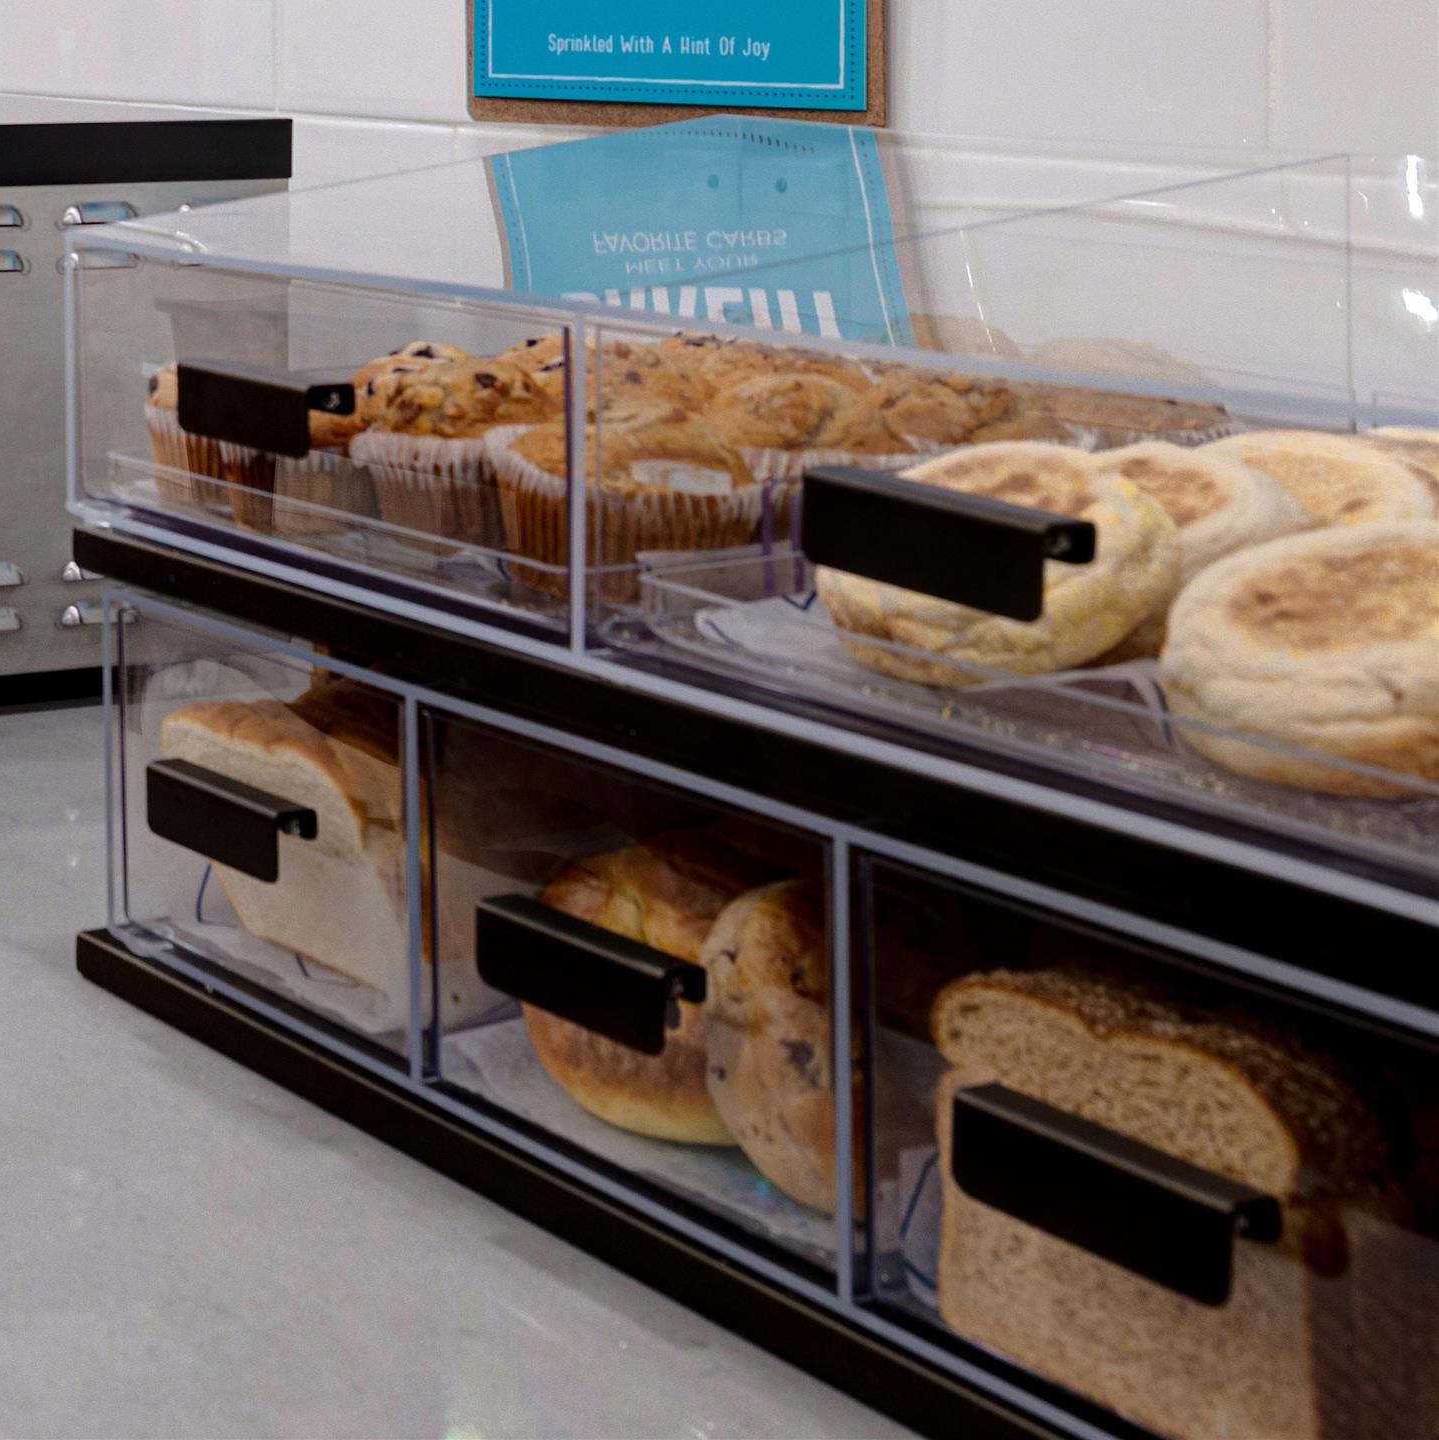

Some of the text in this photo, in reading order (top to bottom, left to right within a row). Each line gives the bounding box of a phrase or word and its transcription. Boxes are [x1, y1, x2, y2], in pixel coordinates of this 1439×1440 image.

[548, 33, 771, 61] Sprinkled With A Hint Of Joy
